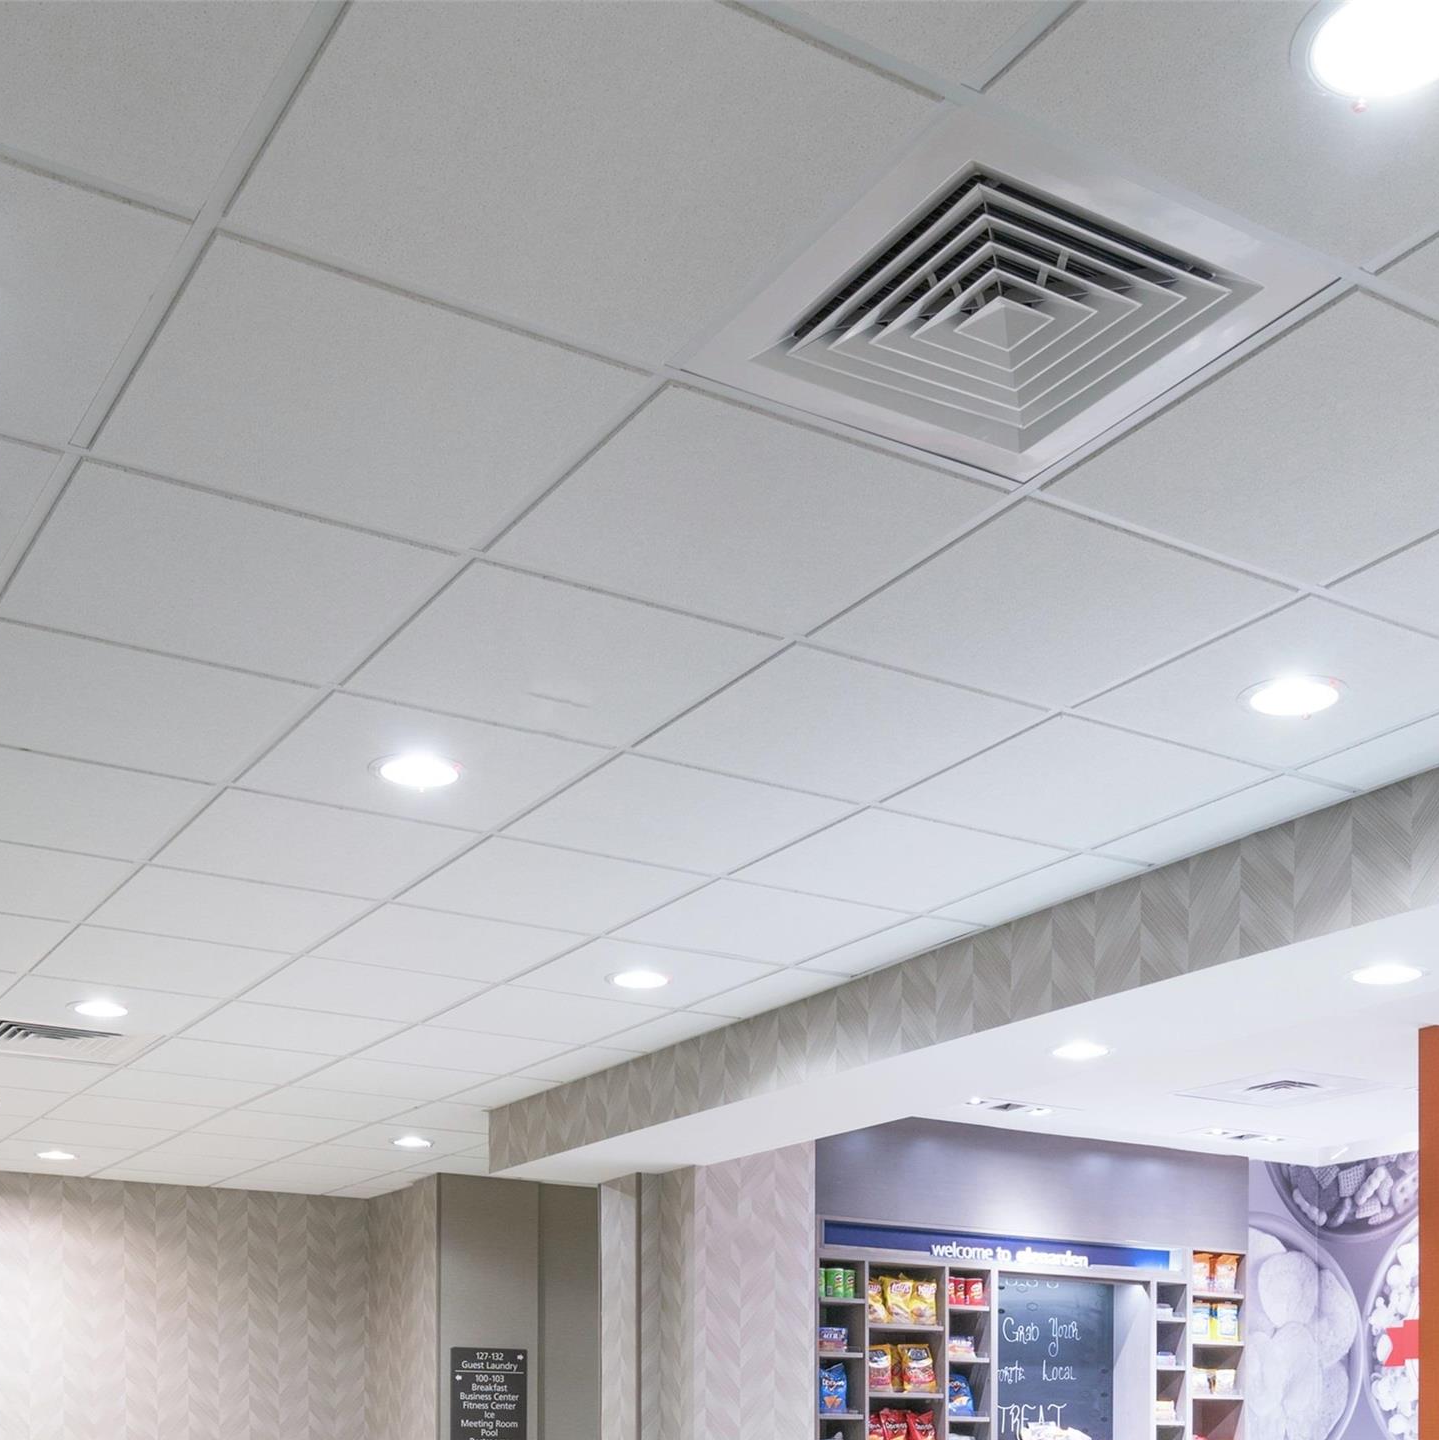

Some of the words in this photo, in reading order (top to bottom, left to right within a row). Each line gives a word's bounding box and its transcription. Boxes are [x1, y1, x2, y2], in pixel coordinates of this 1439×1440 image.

[931, 1241, 994, 1261] welcome
[996, 1246, 1011, 1262] to
[461, 1360, 485, 1370] Guest
[486, 1361, 518, 1371] Laundry
[471, 1383, 508, 1392] Breakfast
[459, 1392, 492, 1401] Business
[493, 1392, 519, 1401] Center
[462, 1401, 489, 1410] Fitness
[490, 1402, 516, 1410] Center
[484, 1411, 495, 1419] Ice
[460, 1420, 494, 1429] Meeting
[495, 1420, 518, 1428] Room
[480, 1429, 499, 1437] Pool
